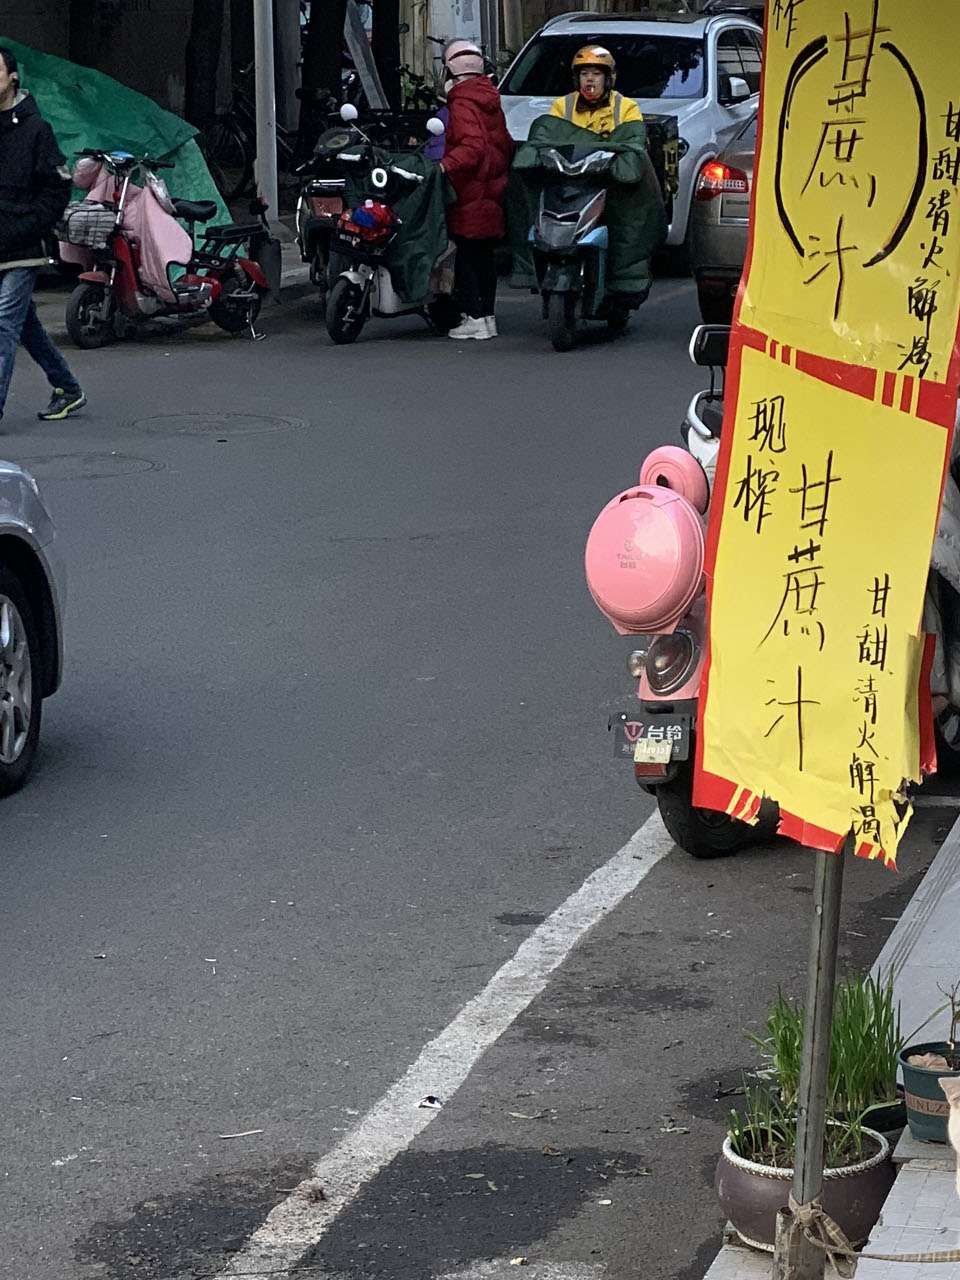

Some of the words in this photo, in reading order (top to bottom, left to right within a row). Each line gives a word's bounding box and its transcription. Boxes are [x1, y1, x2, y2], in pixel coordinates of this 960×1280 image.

[801, 0, 892, 321] 甘蔗汁
[733, 396, 786, 535] 现榨
[757, 450, 842, 772] 甘蔗汁
[648, 725, 682, 740] 台铃
